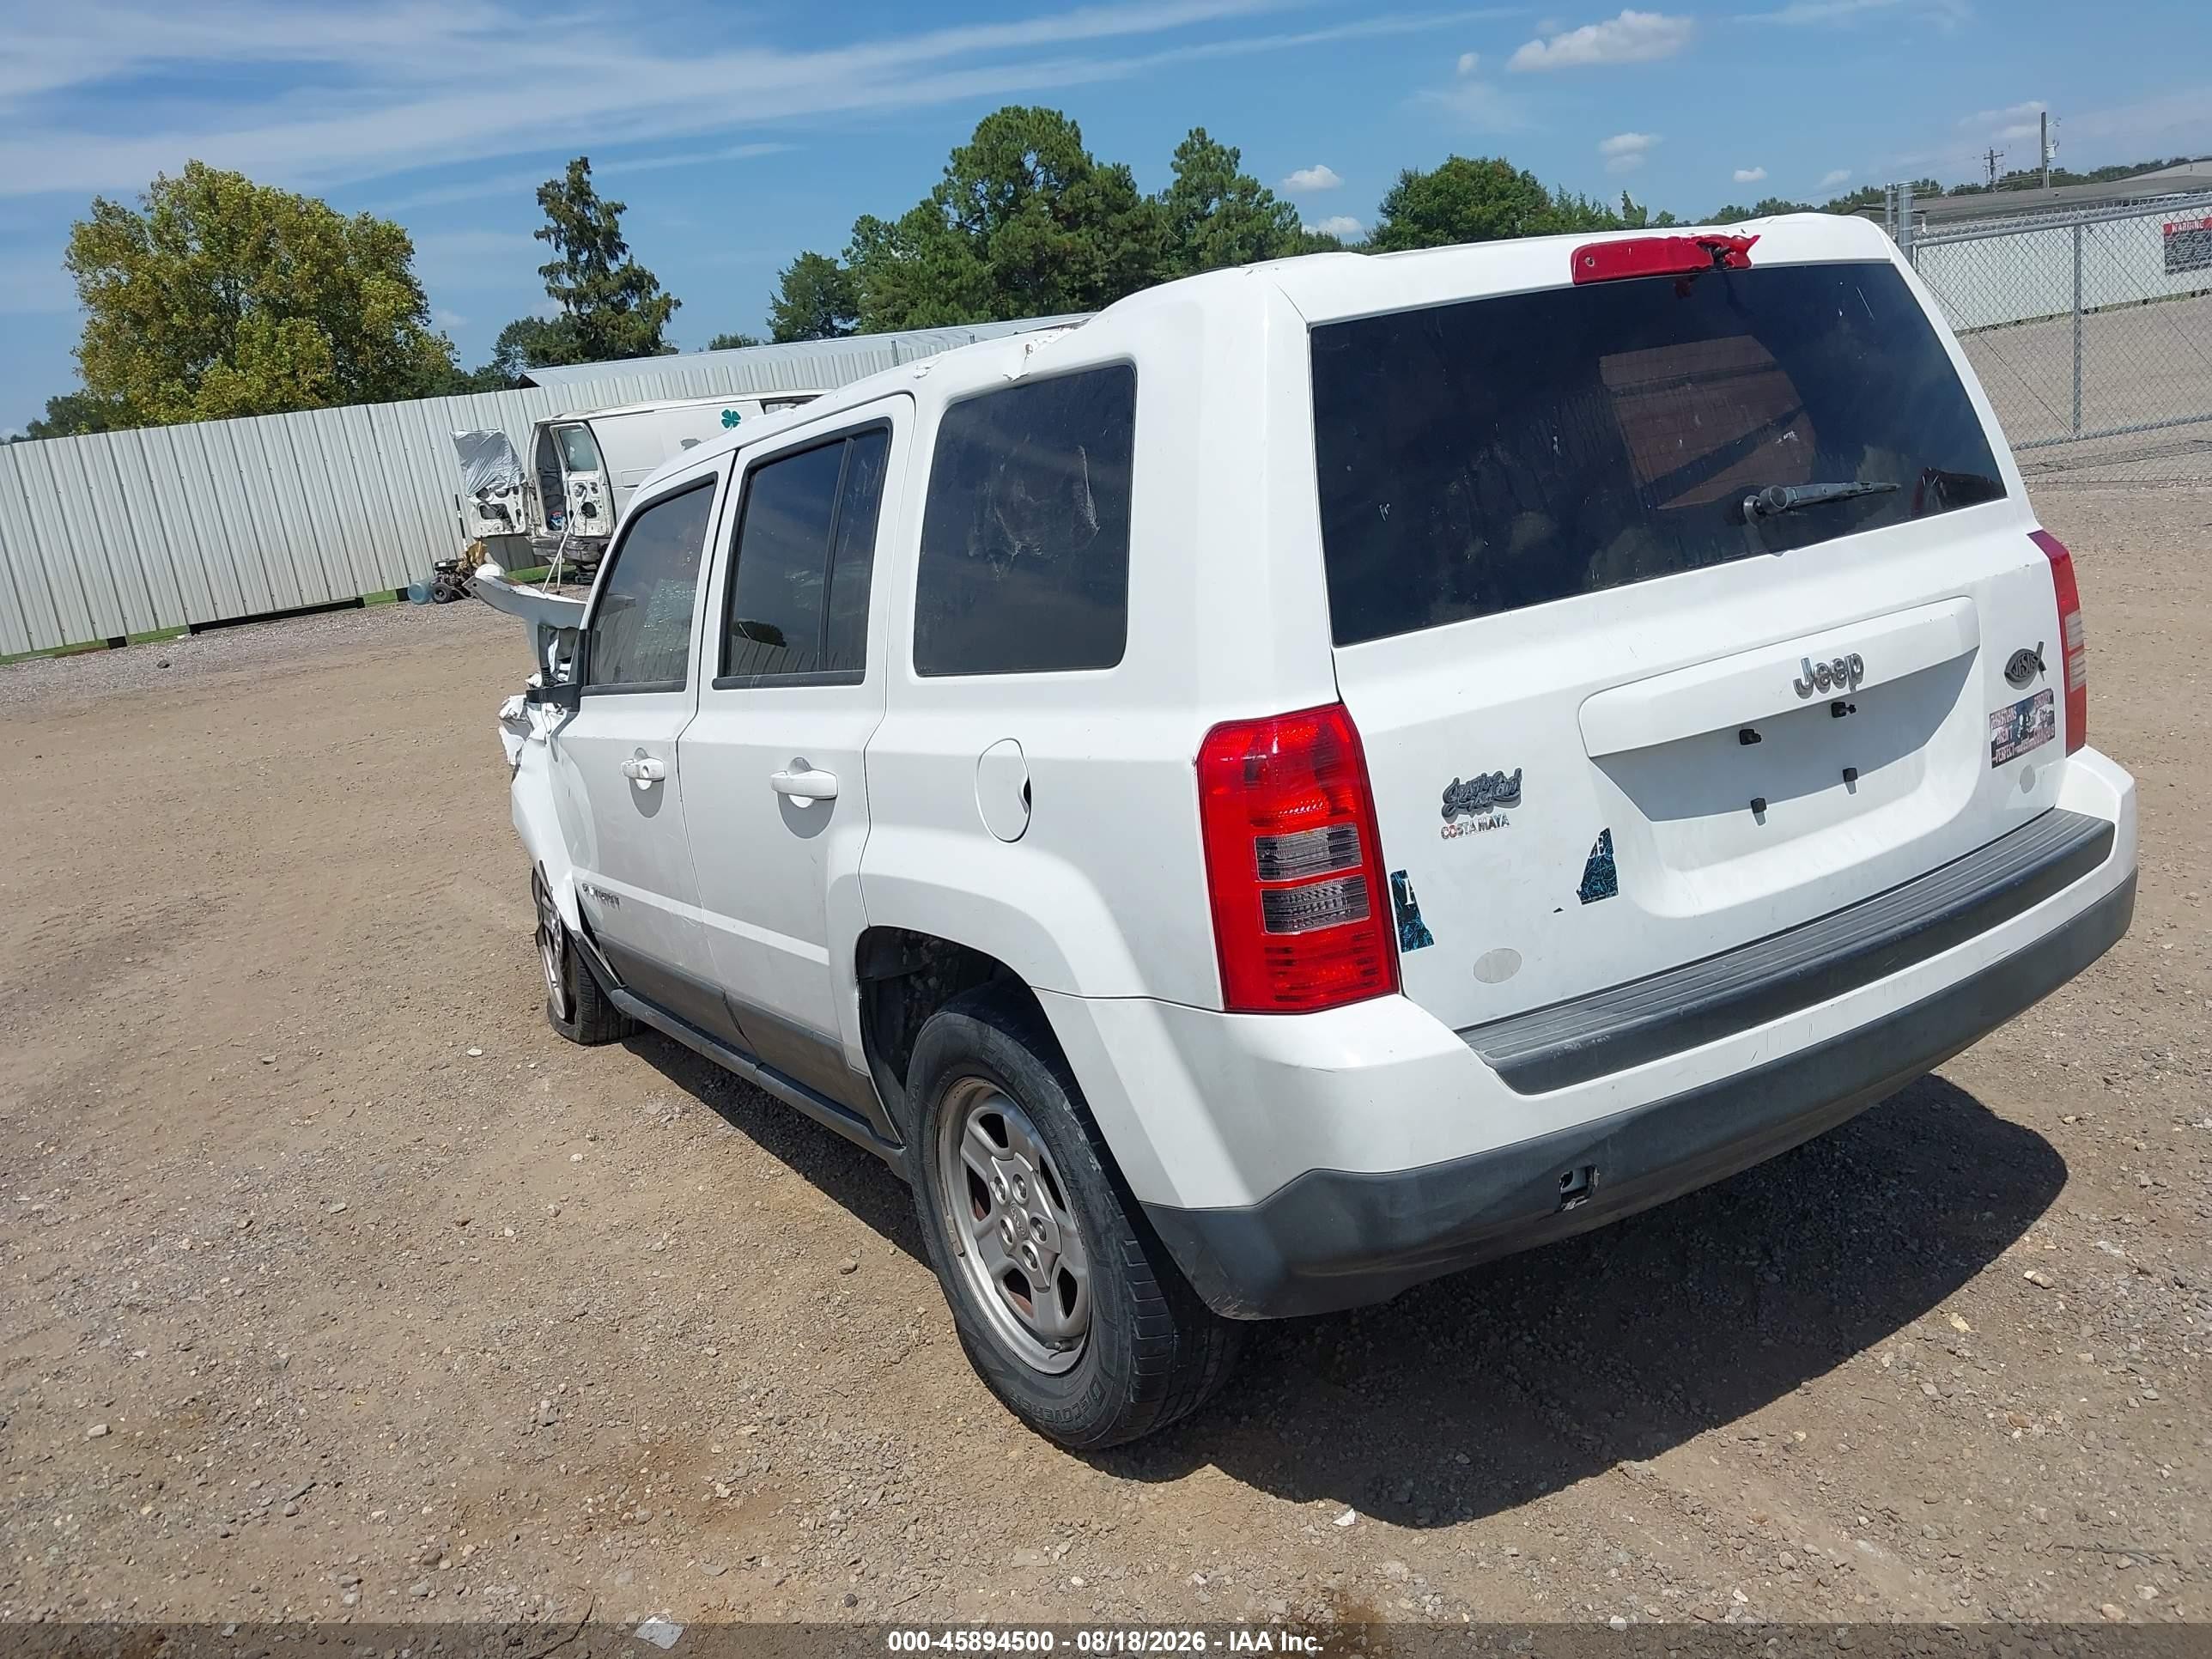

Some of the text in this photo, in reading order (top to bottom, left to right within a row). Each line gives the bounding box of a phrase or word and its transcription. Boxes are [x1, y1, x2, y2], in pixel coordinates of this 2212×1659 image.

[1793, 653, 1863, 695] Jeep
[1441, 813, 1510, 839] COSTA MAYA
